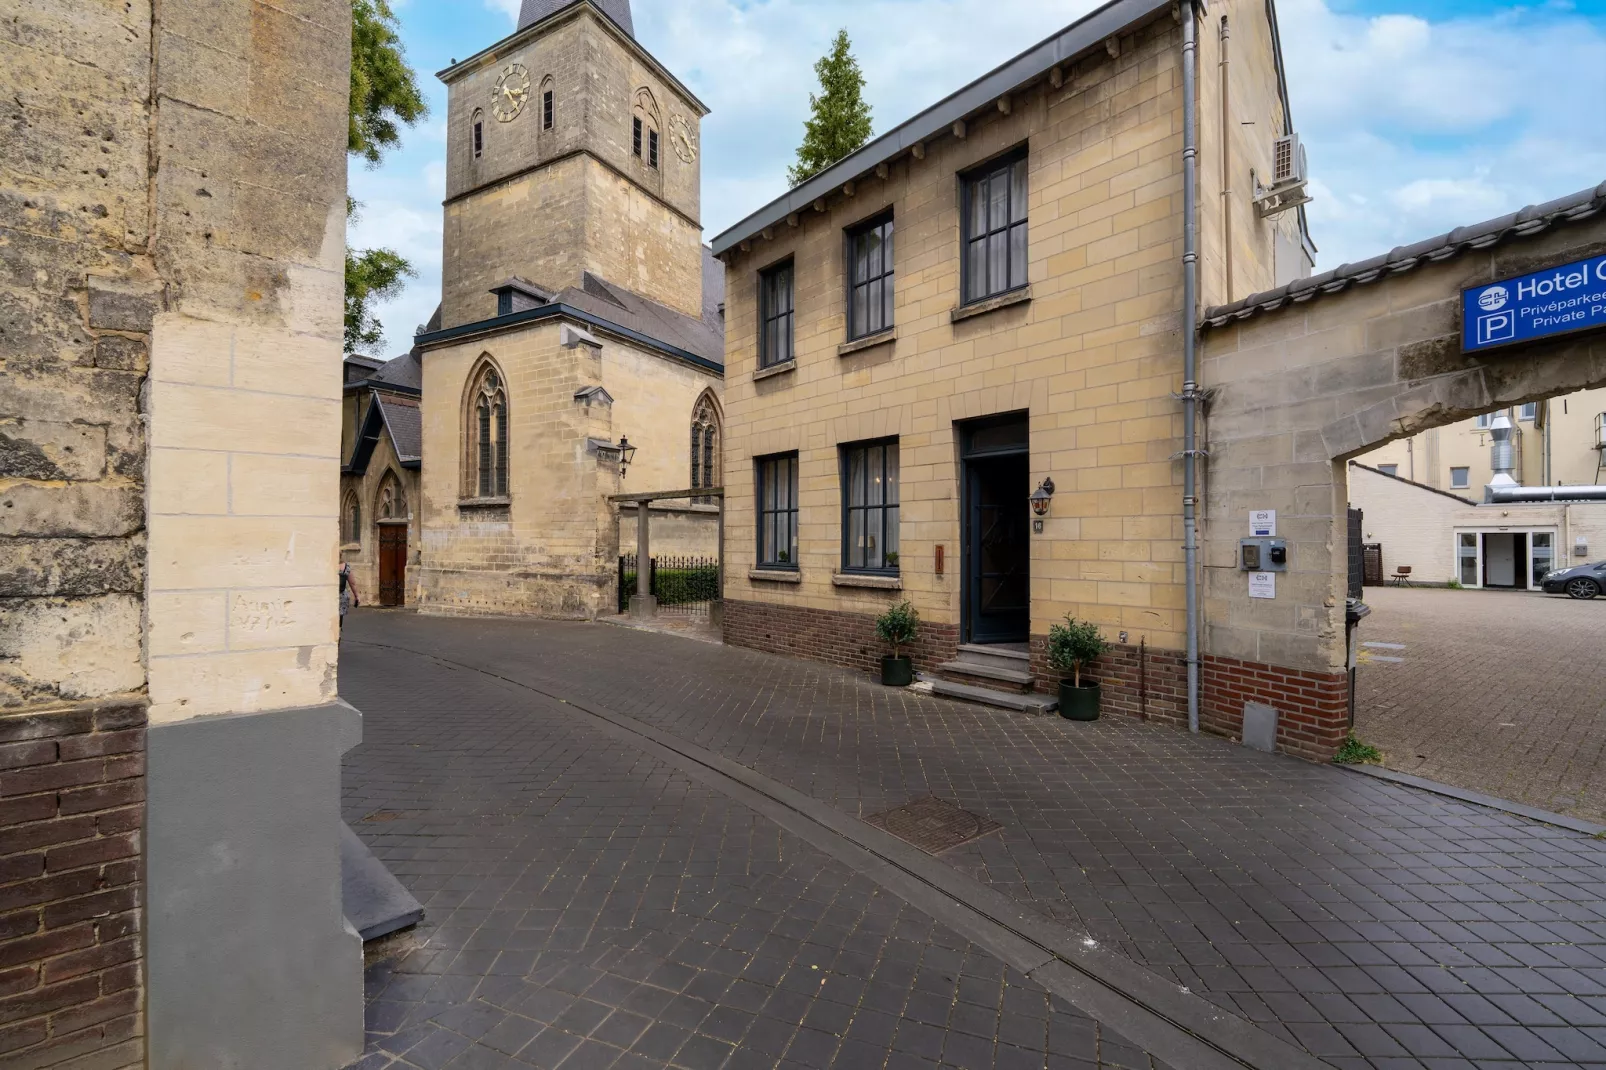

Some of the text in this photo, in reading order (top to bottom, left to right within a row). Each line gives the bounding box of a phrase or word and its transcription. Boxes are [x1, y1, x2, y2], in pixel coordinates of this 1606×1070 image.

[1517, 264, 1588, 301] Hotel
[1486, 315, 1508, 340] P
[1533, 310, 1586, 329] Private
